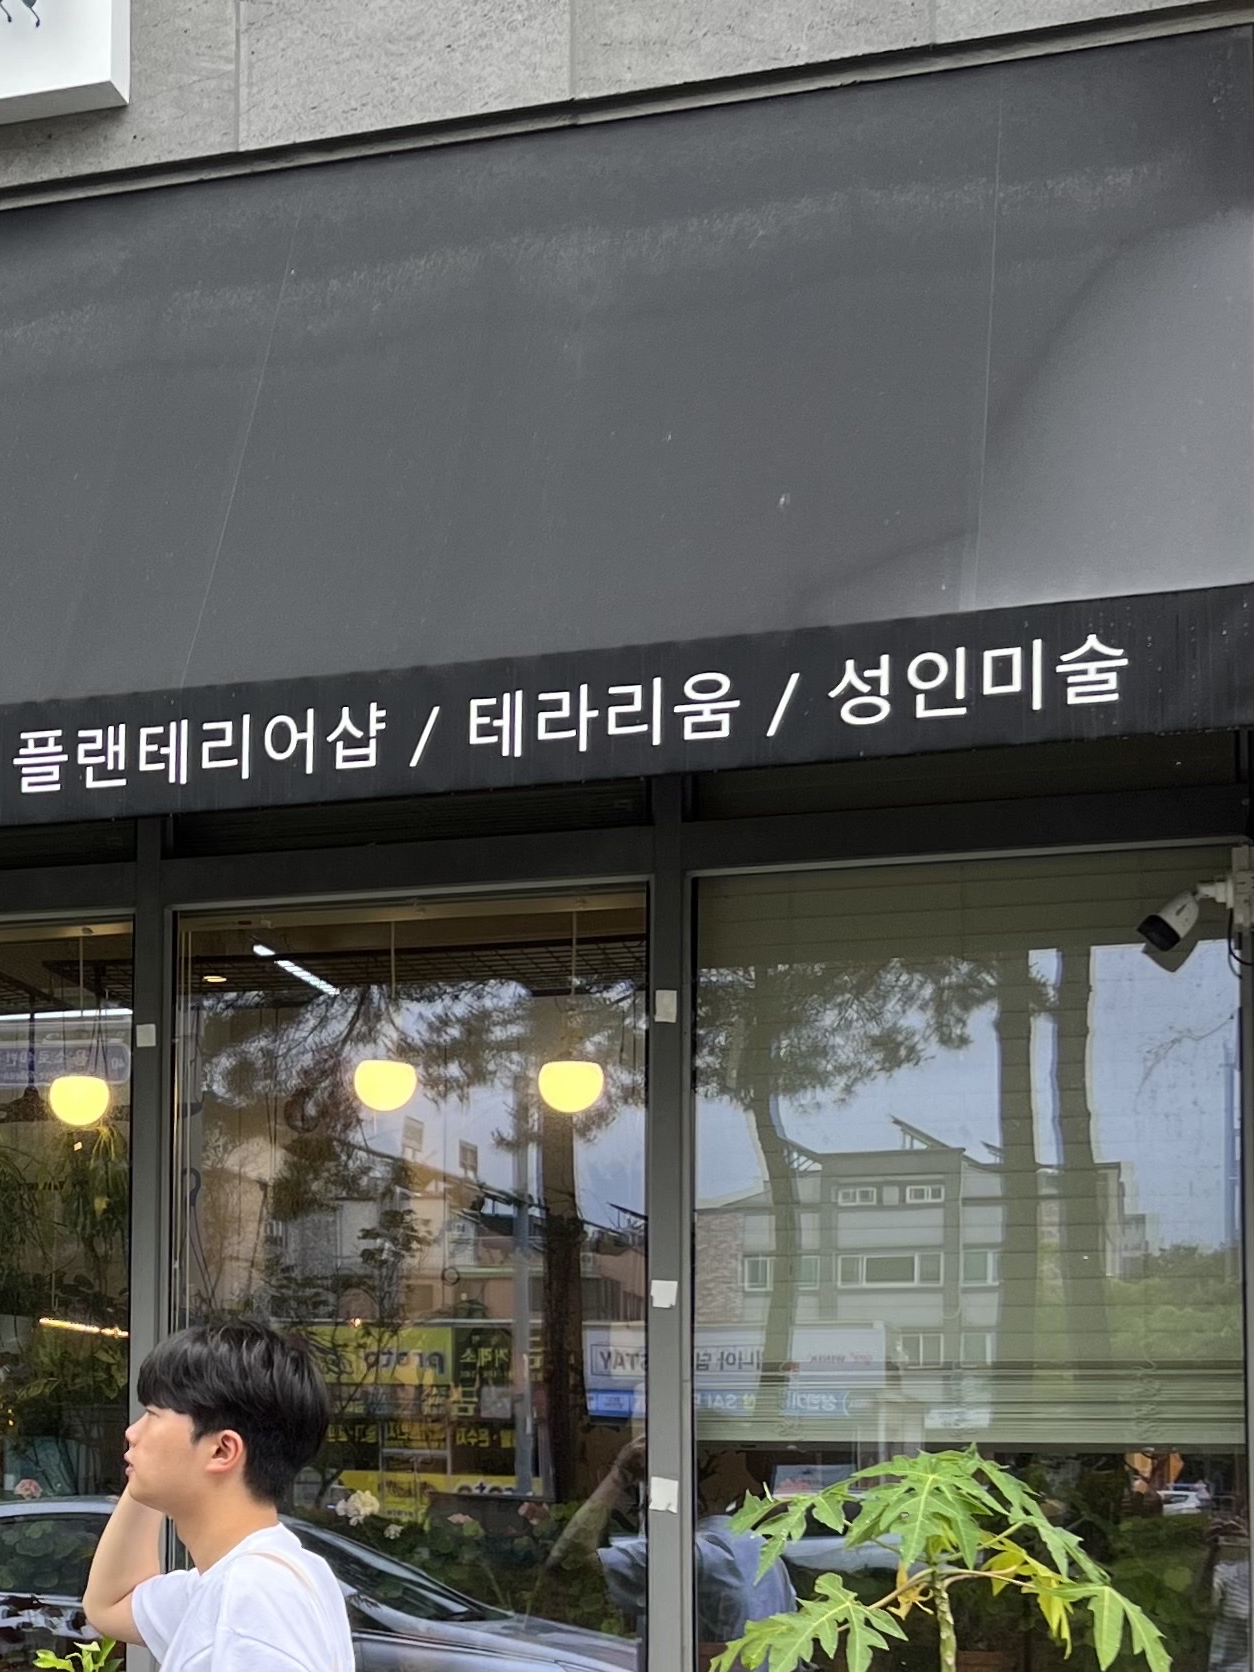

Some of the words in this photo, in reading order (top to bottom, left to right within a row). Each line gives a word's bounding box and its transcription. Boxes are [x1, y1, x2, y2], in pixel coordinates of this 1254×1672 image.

[14, 703, 386, 792] 플랜테리어샵
[410, 707, 439, 766] /
[470, 673, 740, 757] 테라리움
[767, 673, 799, 736] /
[829, 634, 1128, 724] 성인미술
